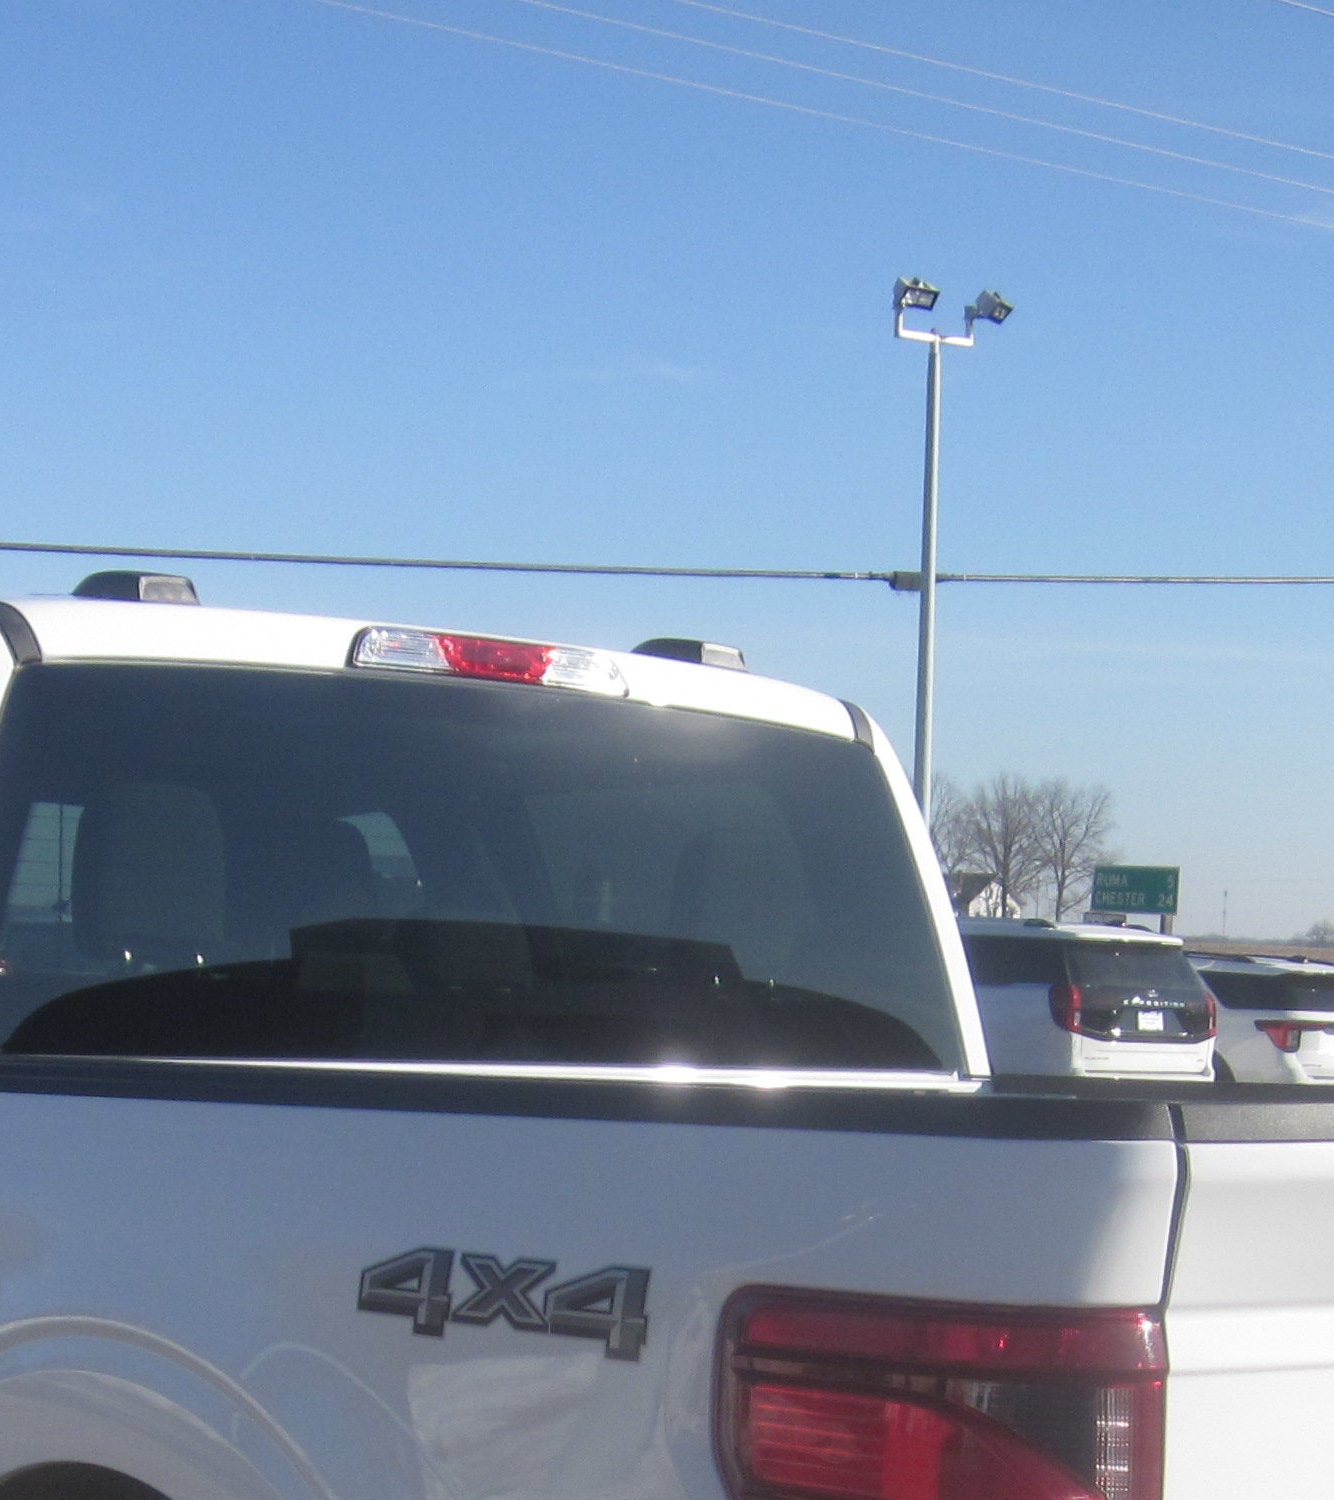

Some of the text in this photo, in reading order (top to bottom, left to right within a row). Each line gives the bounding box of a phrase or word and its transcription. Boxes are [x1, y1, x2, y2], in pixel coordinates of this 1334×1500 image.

[1095, 872, 1129, 887] RUMA
[1094, 890, 1174, 908] CHESTER 24
[1122, 997, 1186, 1008] EPEDITION
